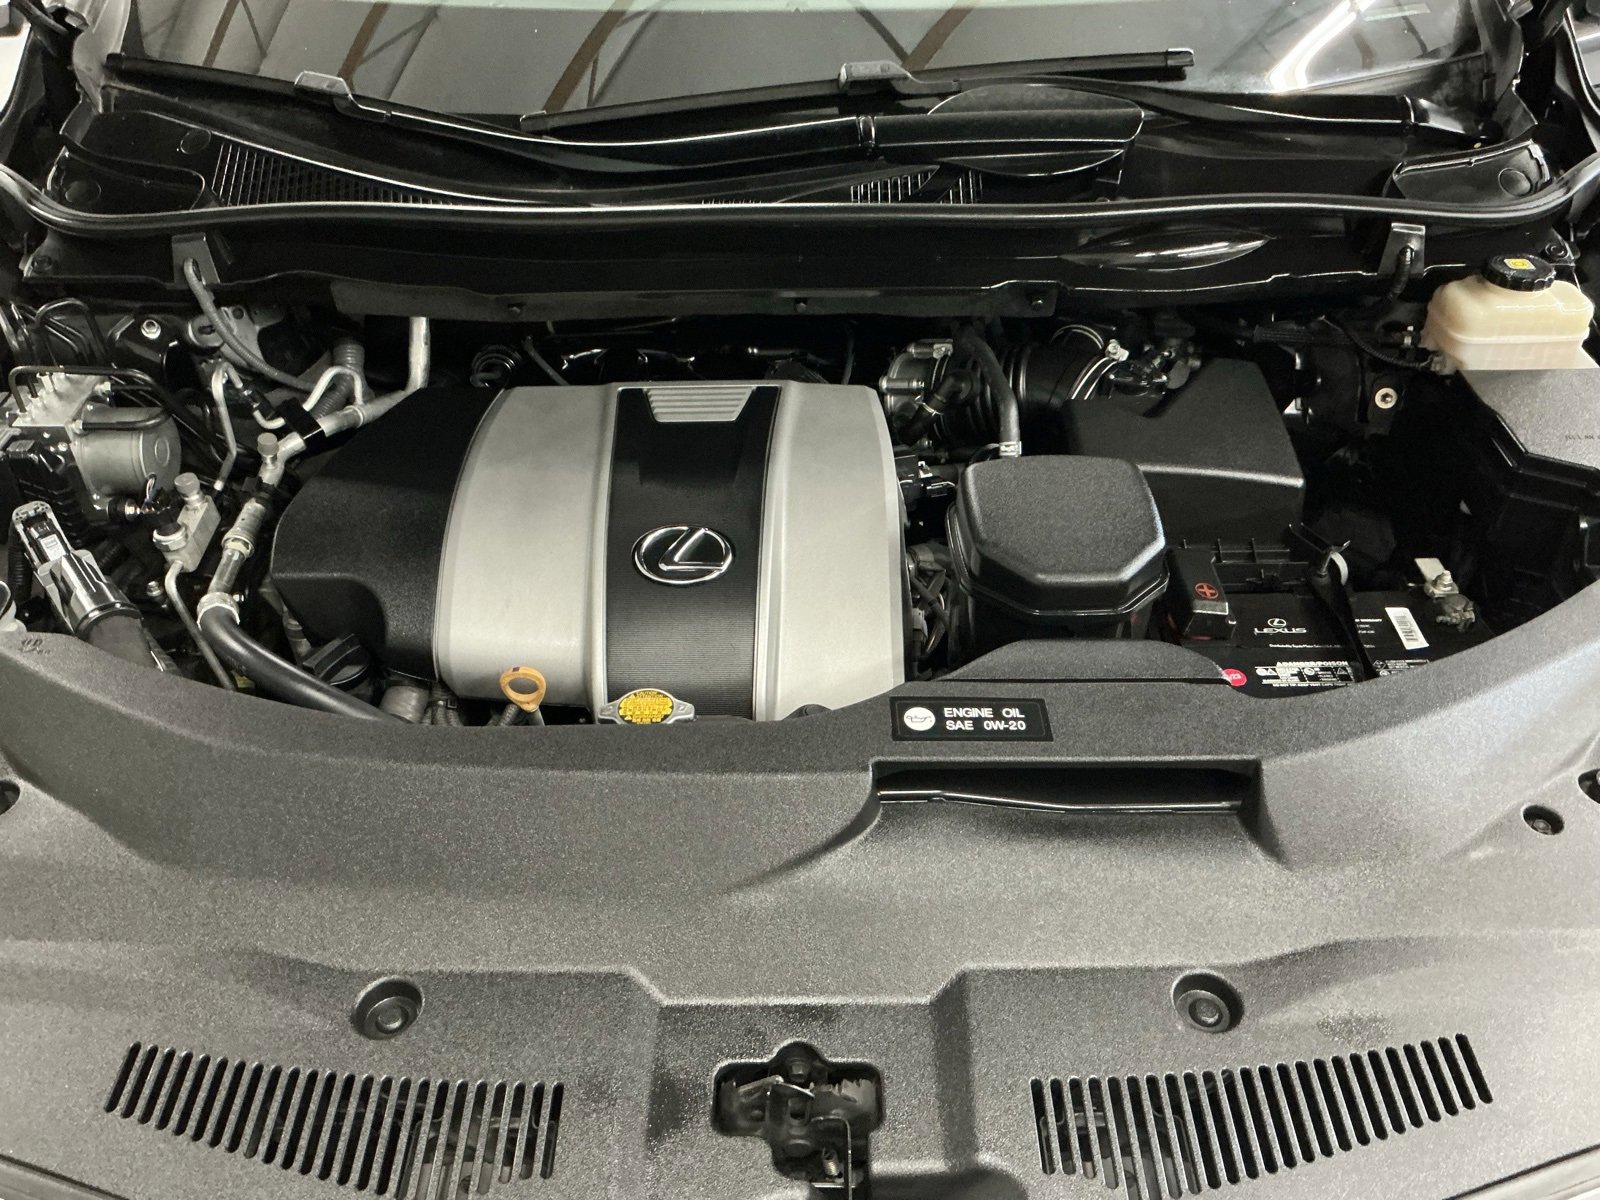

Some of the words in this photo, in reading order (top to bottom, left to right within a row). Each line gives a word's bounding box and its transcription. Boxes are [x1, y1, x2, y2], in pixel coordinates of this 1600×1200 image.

[943, 707, 994, 718] ENGINE
[1002, 707, 1026, 718] OIL
[945, 720, 974, 731] SAE
[983, 720, 1027, 731] 0W-20
